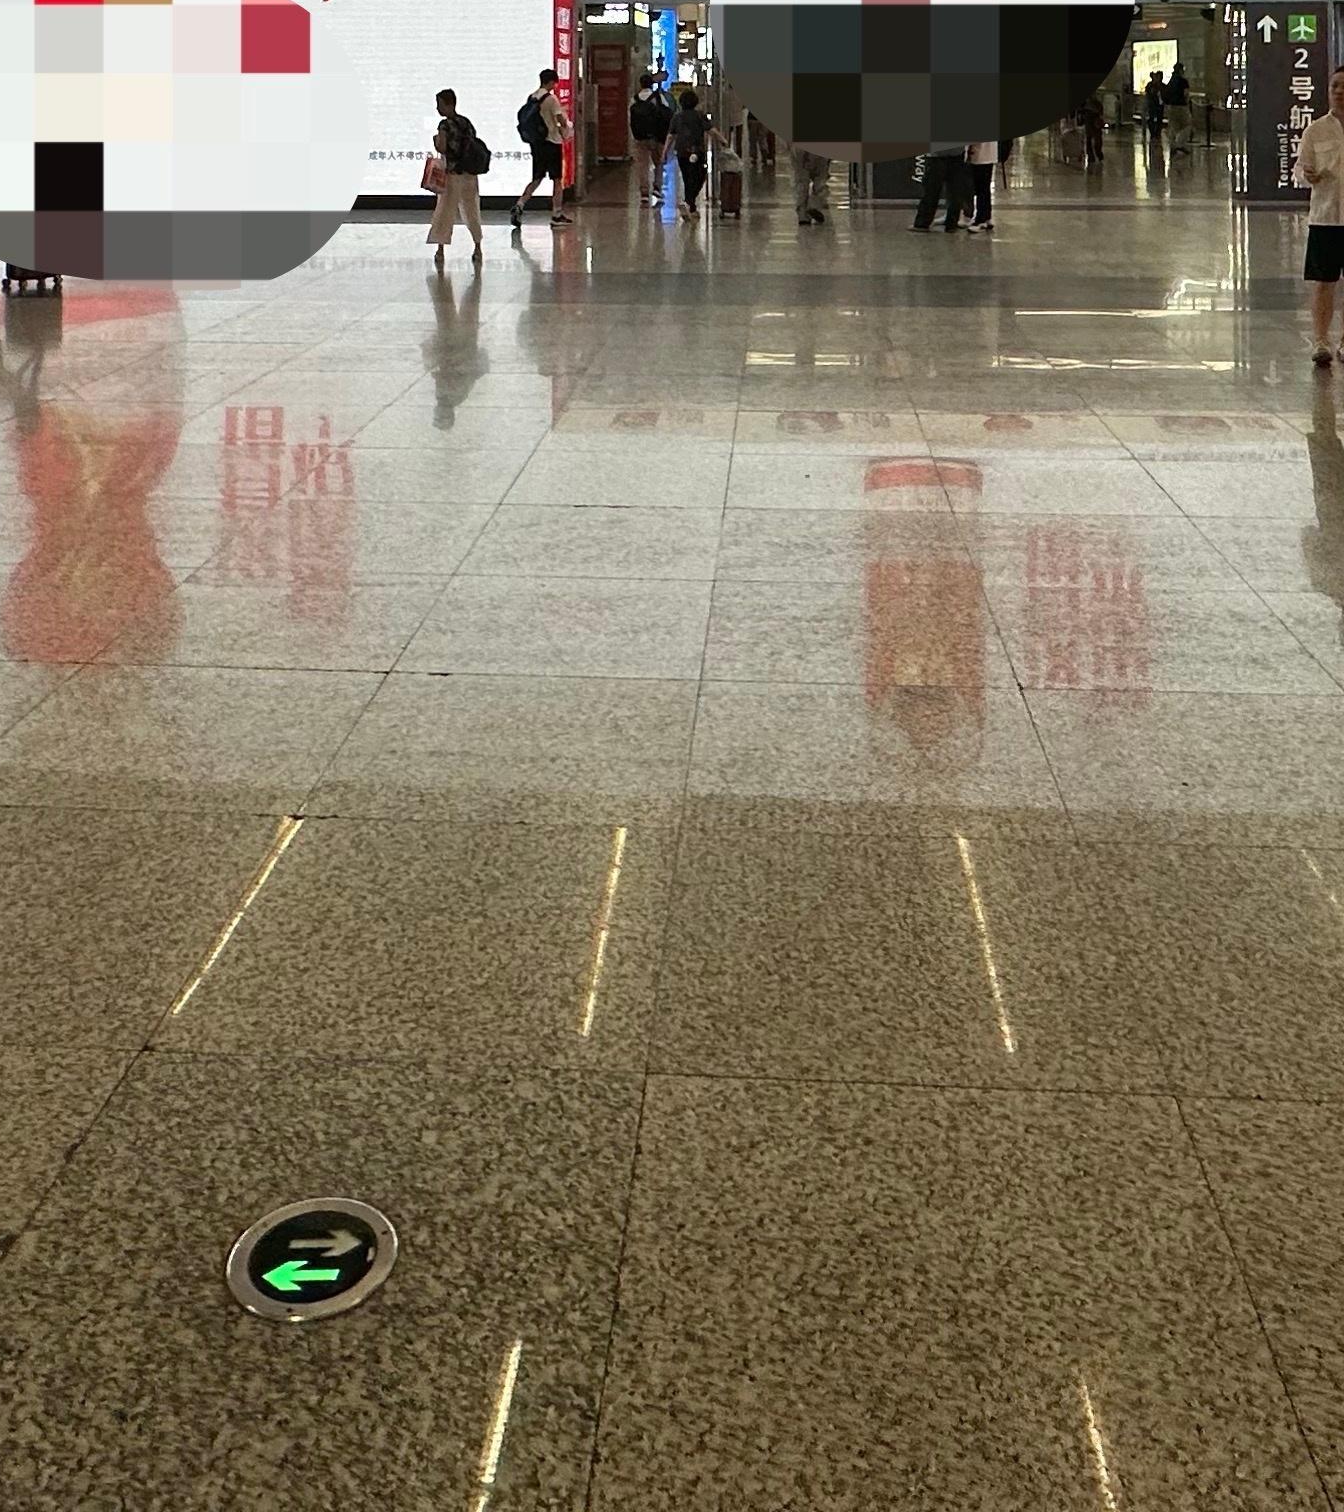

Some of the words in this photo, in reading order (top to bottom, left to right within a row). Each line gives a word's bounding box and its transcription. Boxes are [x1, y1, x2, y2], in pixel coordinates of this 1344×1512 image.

[1276, 122, 1288, 130] 2
[911, 154, 926, 183] way
[1276, 134, 1289, 189] Terminal
